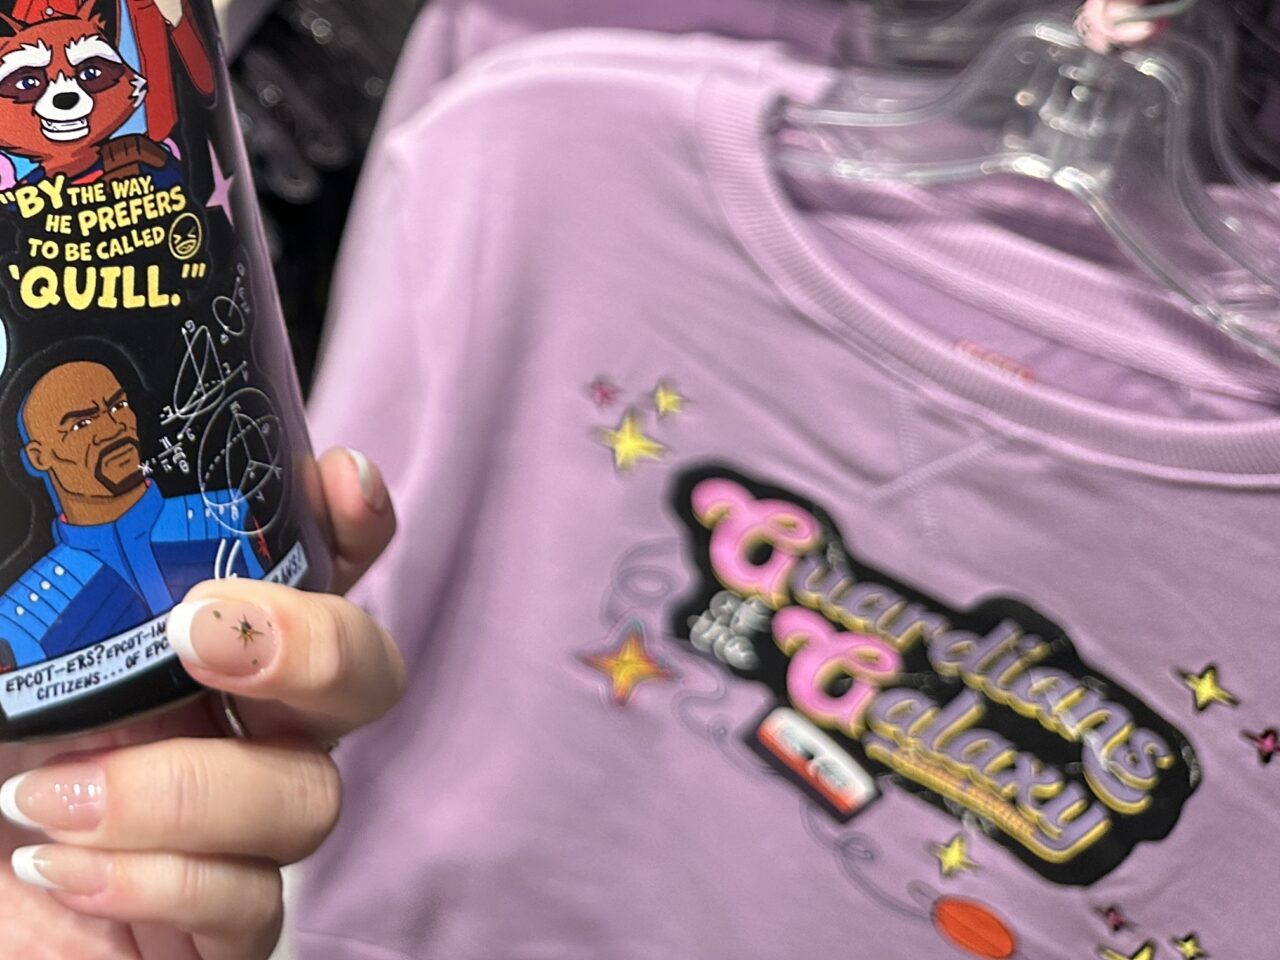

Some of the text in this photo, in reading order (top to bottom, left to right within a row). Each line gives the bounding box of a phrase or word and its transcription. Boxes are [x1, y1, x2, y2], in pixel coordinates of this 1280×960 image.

[45, 185, 187, 237] HE PREFERS
[67, 182, 106, 207] THE
[27, 226, 165, 262] TO BE CALLED
[6, 644, 105, 693] EPCOT-ERS?
[125, 650, 142, 669] OF
[691, 477, 1173, 815] Guardians
[772, 605, 1111, 864] Galaxy
